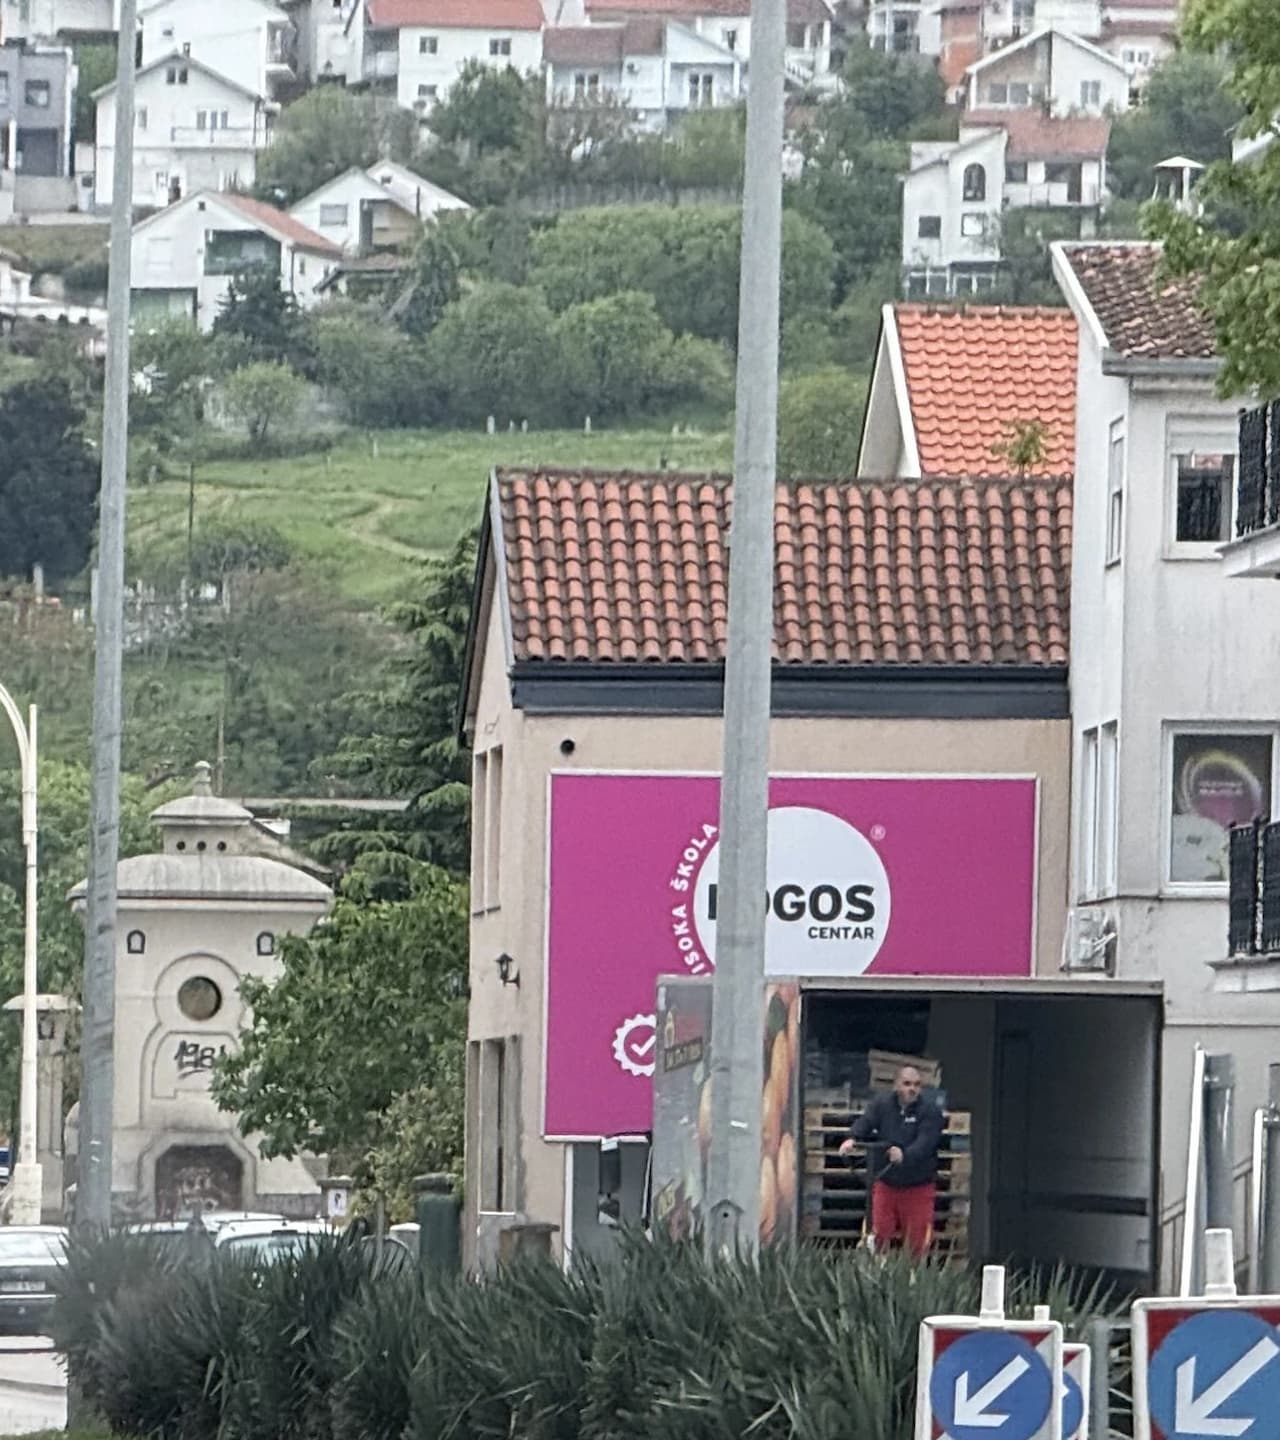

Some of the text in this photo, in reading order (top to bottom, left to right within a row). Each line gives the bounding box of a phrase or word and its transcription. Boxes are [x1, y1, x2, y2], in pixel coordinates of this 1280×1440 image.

[670, 824, 718, 977] ISOKA ŠKOLA
[708, 884, 875, 922] GOS
[808, 927, 874, 940] CENTAR
